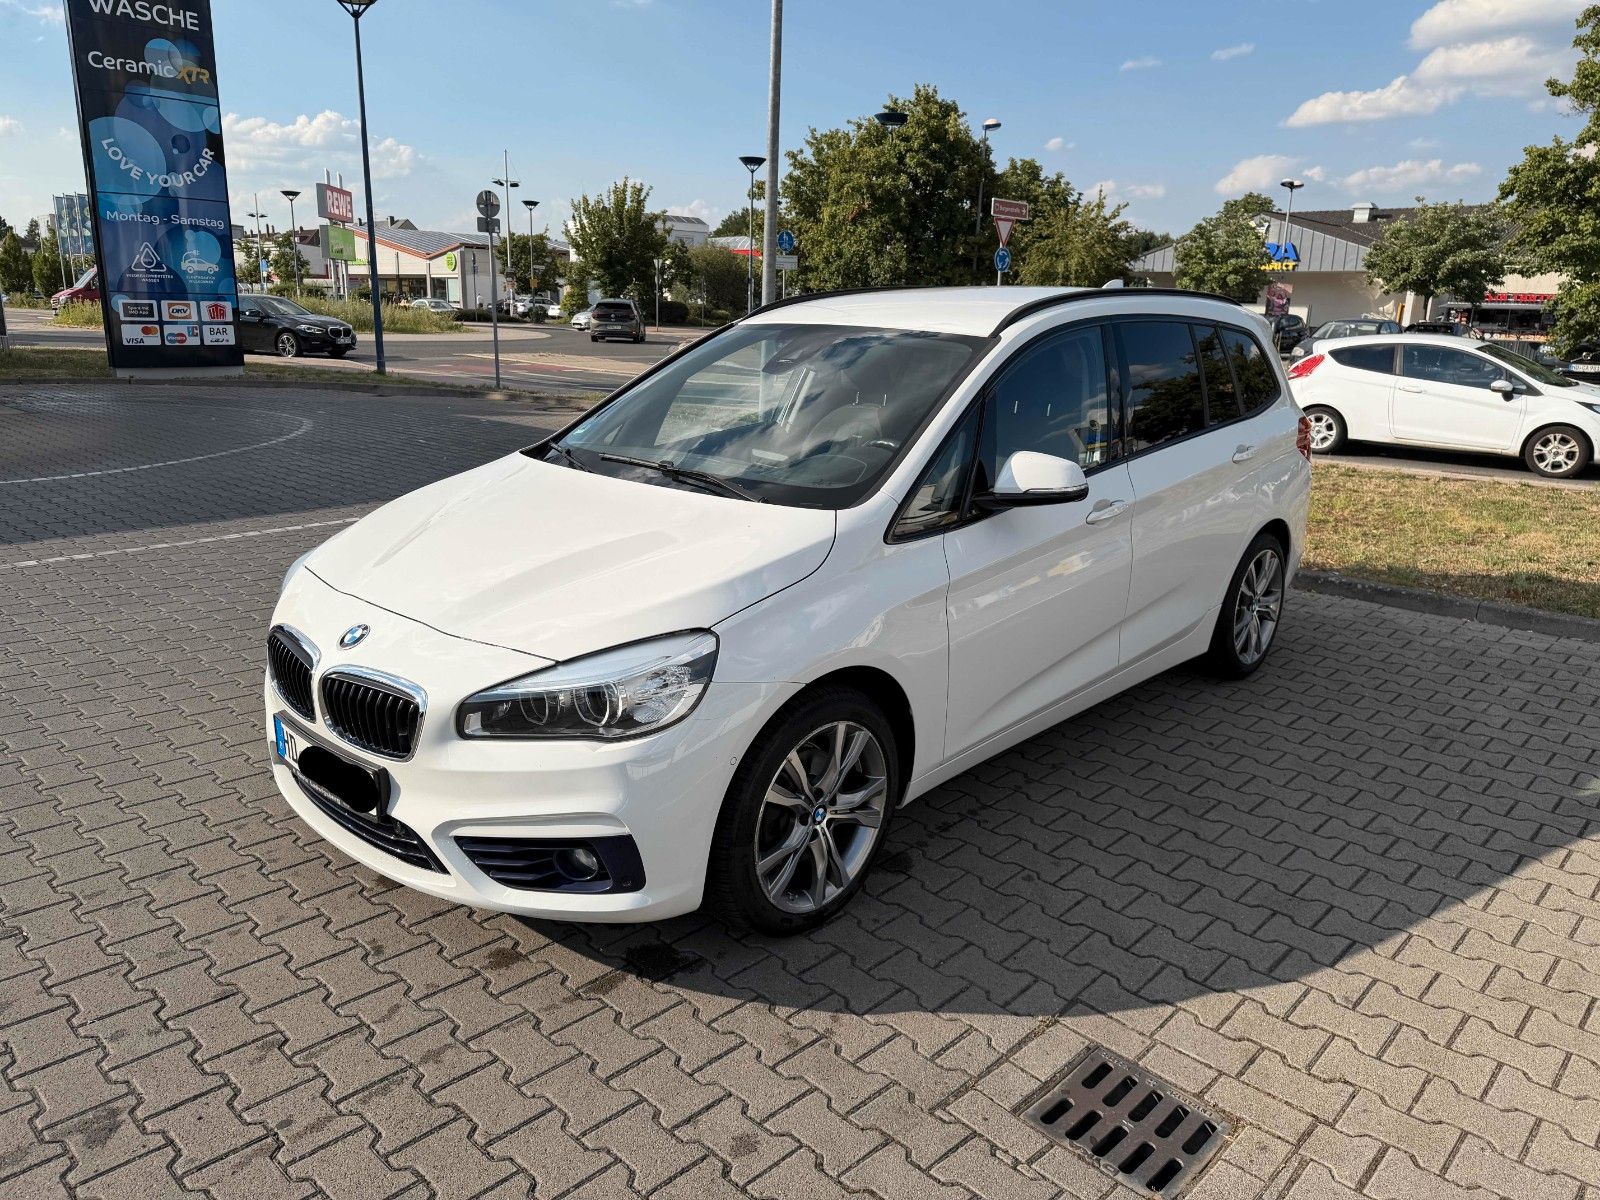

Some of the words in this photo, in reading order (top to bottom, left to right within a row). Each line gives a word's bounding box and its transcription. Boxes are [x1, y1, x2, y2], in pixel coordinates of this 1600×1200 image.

[101, 138, 144, 181] LOVE
[145, 170, 195, 188] YOUR
[193, 147, 215, 177] CAR
[326, 189, 352, 218] REWE
[106, 210, 160, 225] Montag
[171, 214, 225, 230] Samstag
[209, 327, 228, 336] BAR
